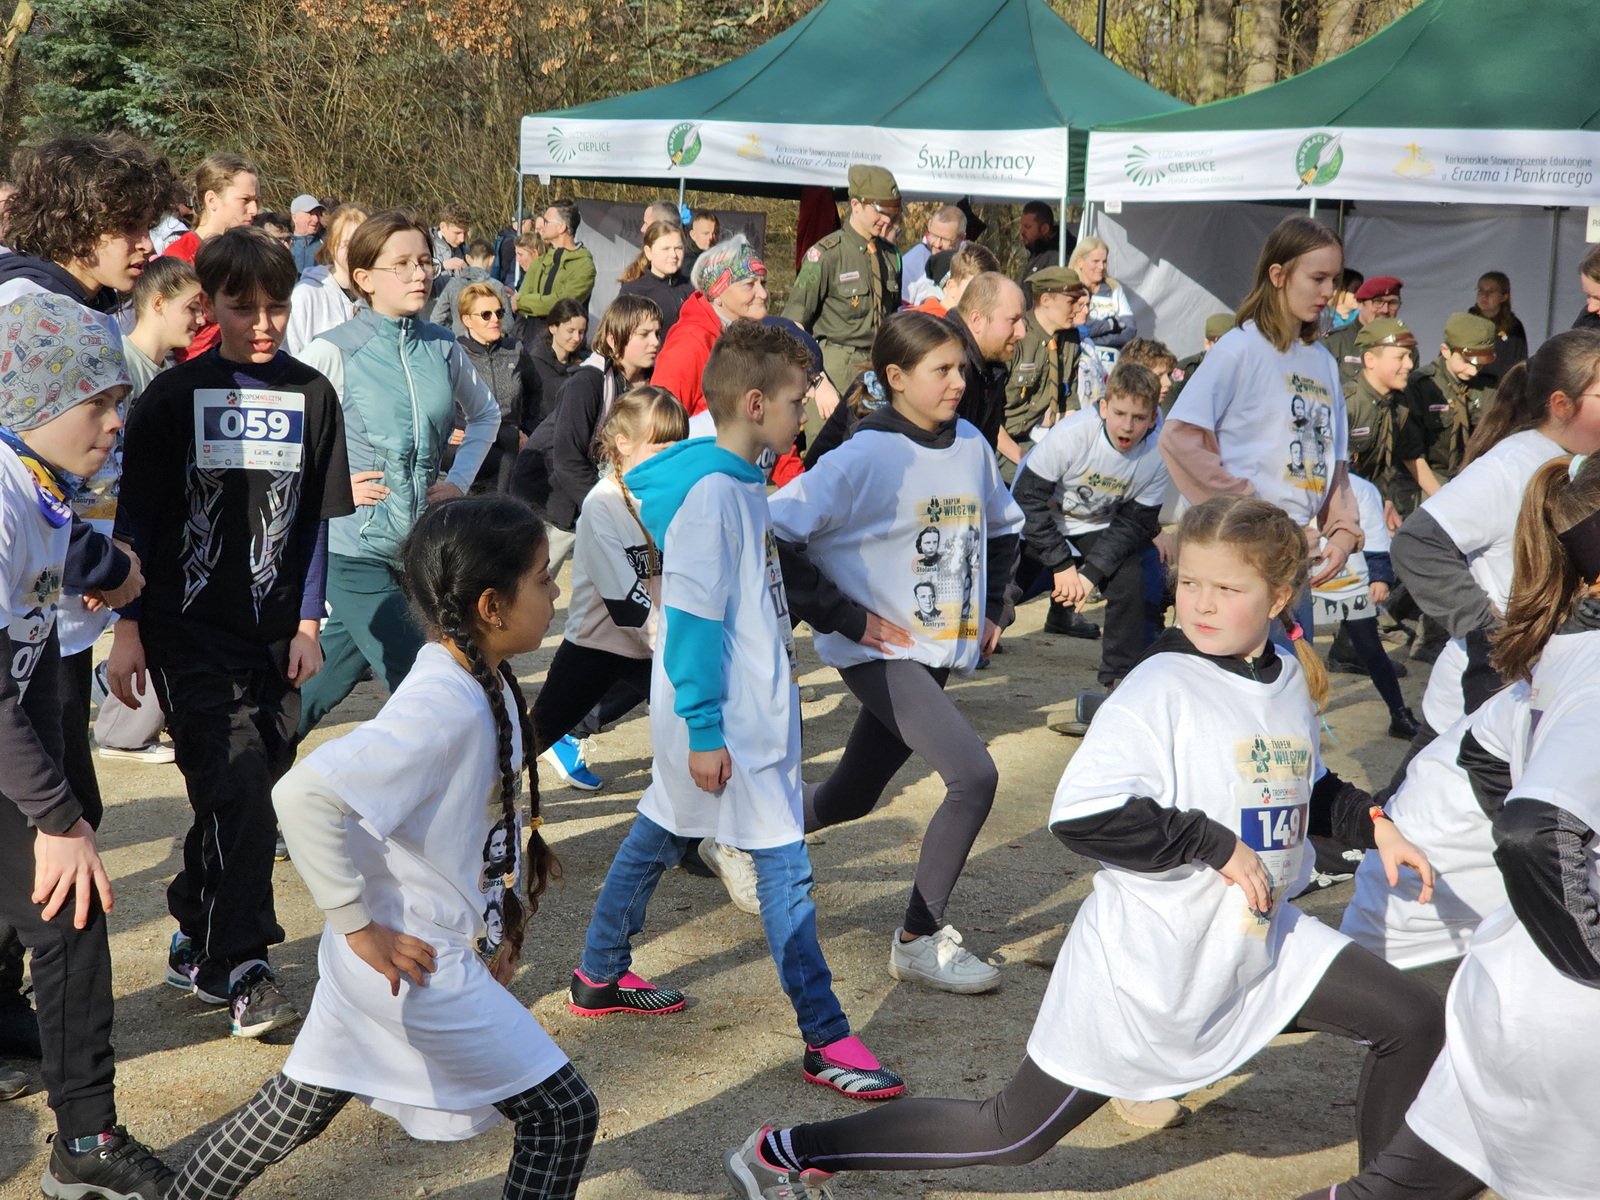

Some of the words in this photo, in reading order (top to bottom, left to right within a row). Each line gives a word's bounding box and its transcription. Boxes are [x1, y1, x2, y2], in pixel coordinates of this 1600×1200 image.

[578, 141, 612, 153] CIEPLICE
[1167, 160, 1217, 173] CIEPLICE
[1452, 167, 1500, 182] Erazma
[1504, 168, 1510, 182] i
[1513, 168, 1593, 188] Pankracego
[219, 409, 290, 440] 059
[943, 504, 976, 516] WILCZYM
[1271, 740, 1291, 749] TROPEM
[1273, 750, 1308, 765] WILCZYM
[1258, 807, 1300, 848] 149
